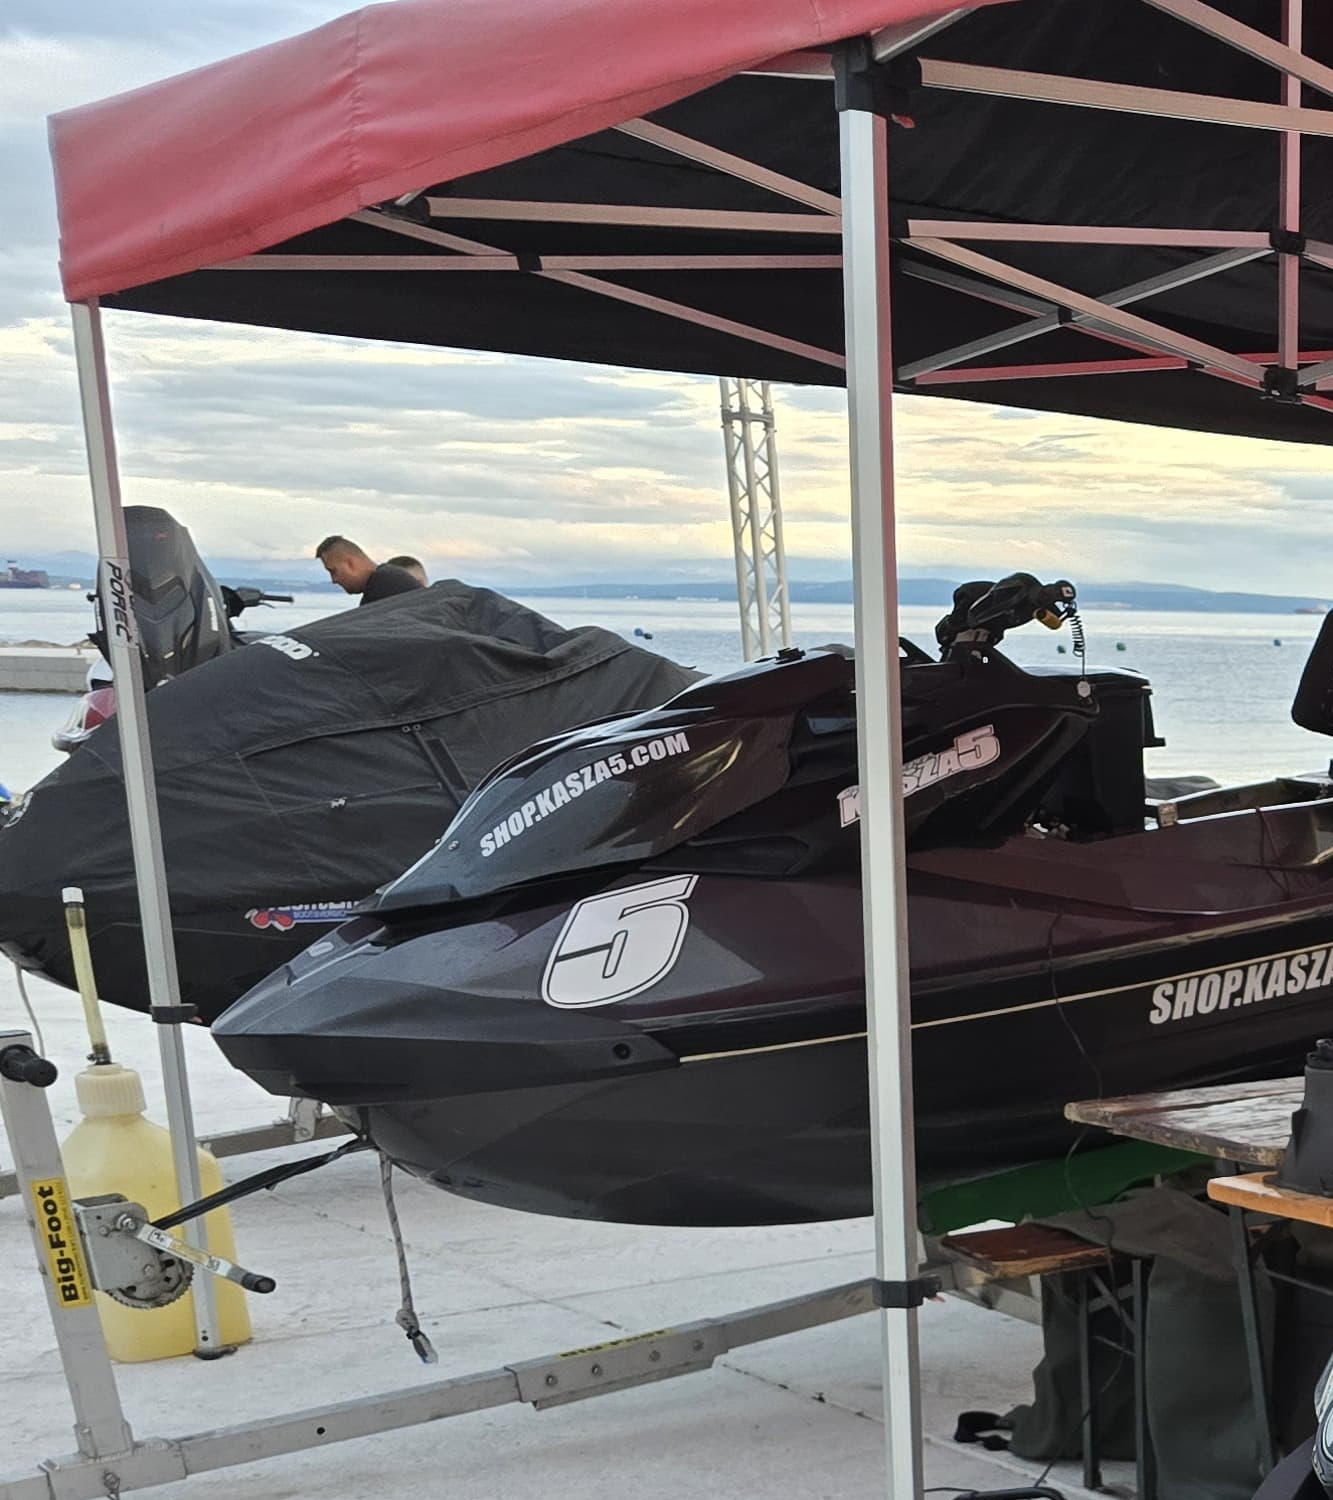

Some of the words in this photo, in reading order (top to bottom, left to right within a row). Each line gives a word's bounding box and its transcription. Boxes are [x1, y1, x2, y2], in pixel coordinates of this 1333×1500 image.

[479, 732, 690, 857] SHOP.KASZA5.COM
[541, 874, 700, 1009] 5
[37, 1186, 80, 1302] Big-Foot
